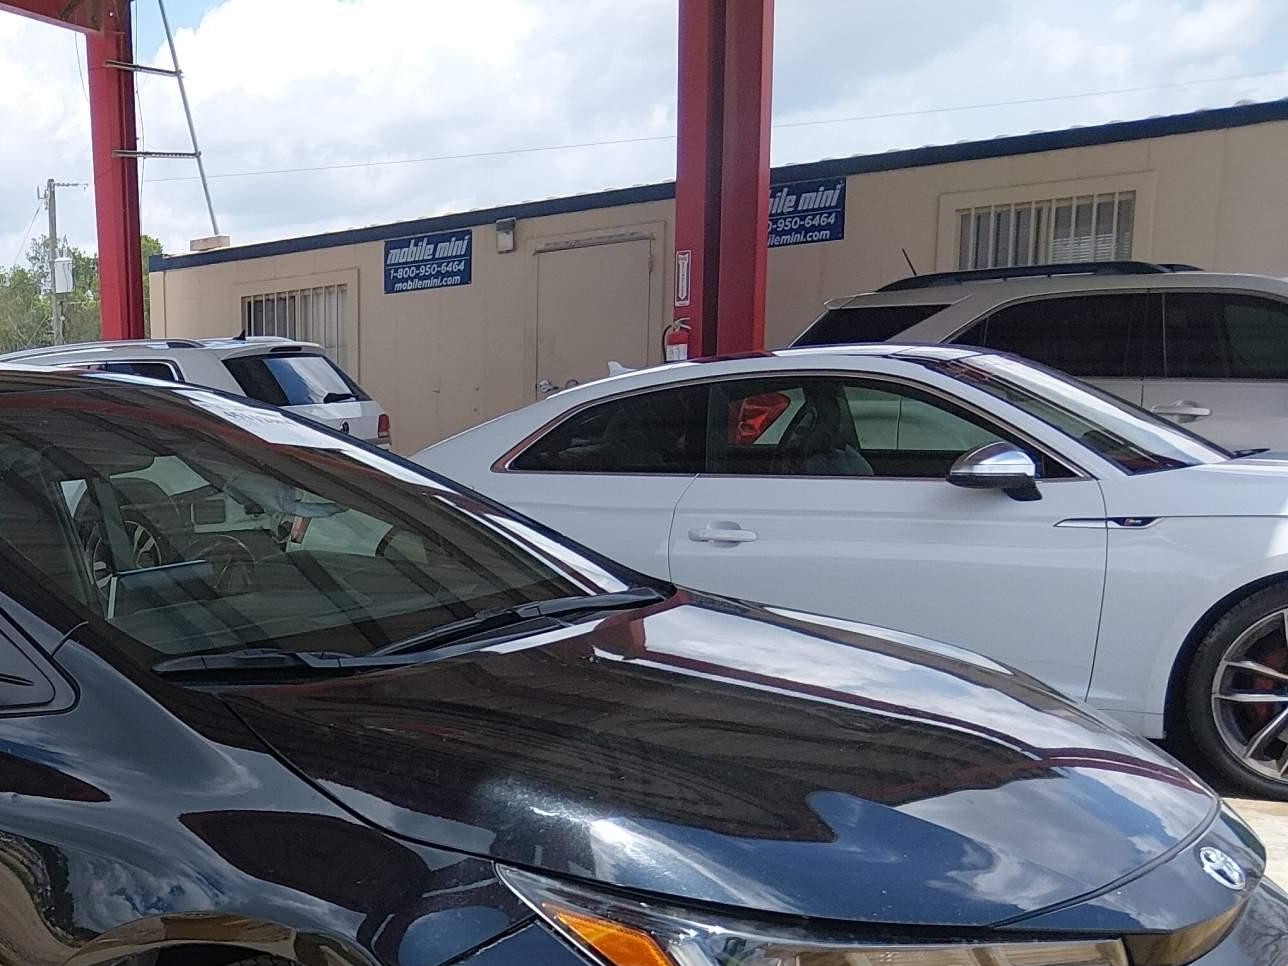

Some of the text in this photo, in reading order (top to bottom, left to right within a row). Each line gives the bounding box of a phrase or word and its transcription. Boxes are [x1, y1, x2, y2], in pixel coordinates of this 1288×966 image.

[768, 183, 843, 215] ile mini
[386, 234, 471, 264] mobile mini
[390, 260, 465, 280] 1-800-950-6464
[394, 275, 461, 292] mobilemini.com
